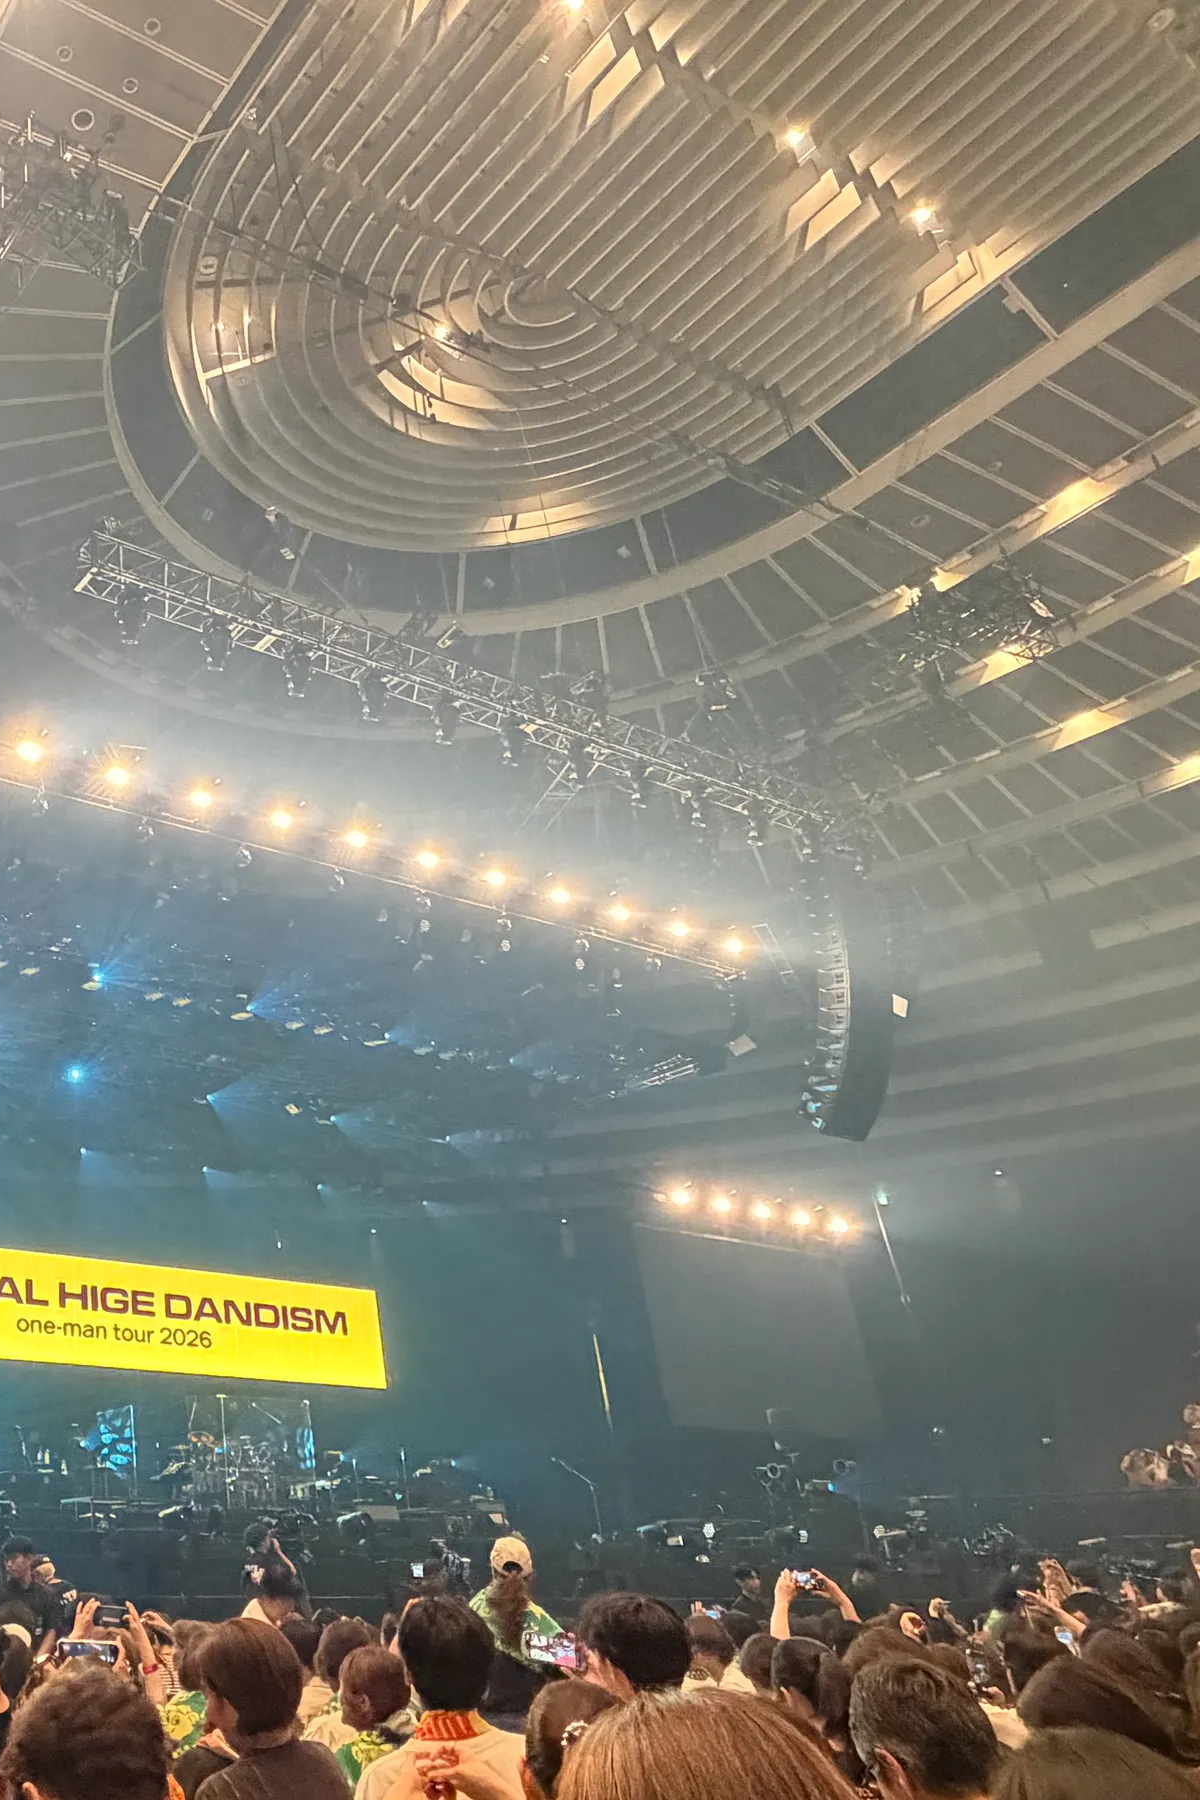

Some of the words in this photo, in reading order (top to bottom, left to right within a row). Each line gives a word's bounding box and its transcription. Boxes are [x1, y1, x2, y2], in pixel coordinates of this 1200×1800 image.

[58, 1281, 156, 1317] HIGE
[165, 1293, 348, 1336] DANDISM
[16, 1318, 108, 1340] one-man
[113, 1322, 155, 1344] tour
[160, 1327, 212, 1349] 2026
